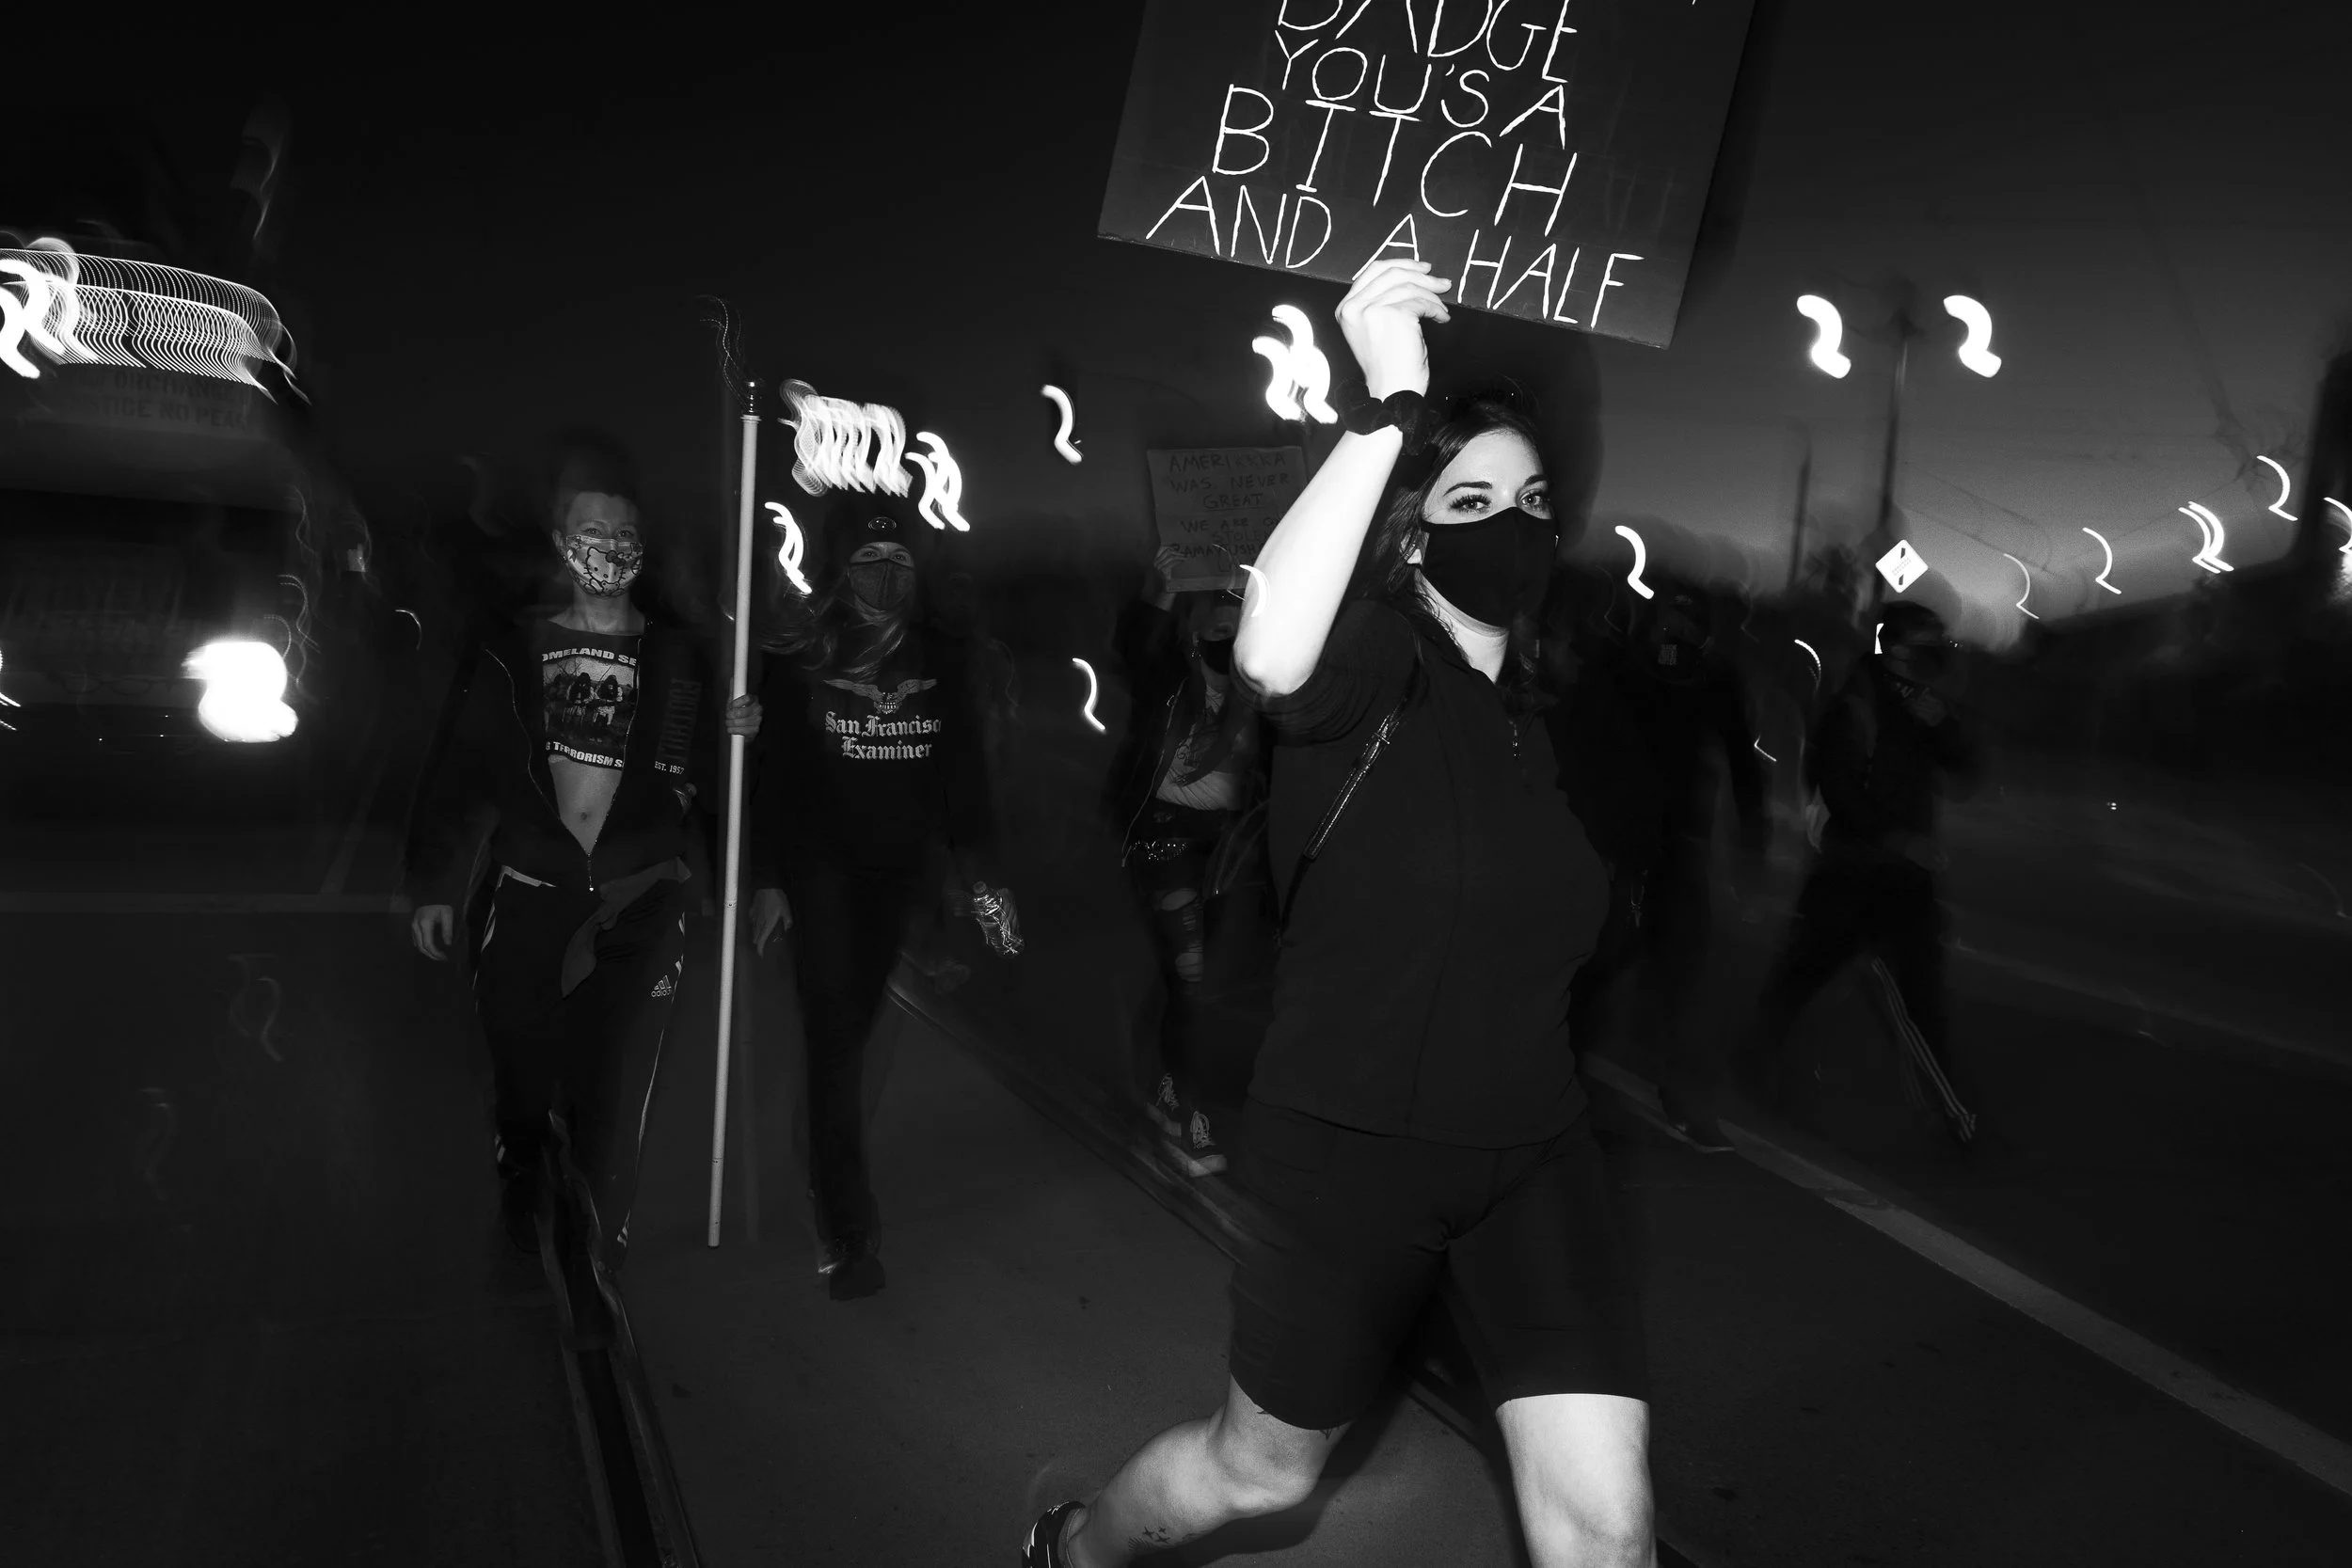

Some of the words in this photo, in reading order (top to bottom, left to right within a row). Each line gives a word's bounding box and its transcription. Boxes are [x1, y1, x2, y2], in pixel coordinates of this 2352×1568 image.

[1274, 29, 1489, 128] YOU'S
[1499, 84, 1565, 150] A
[1212, 83, 1578, 237] BITCH
[1145, 176, 1332, 269] AND
[1352, 213, 1420, 280] A
[1456, 229, 1645, 330] HALF
[1169, 477, 1213, 494] WAS
[1230, 473, 1290, 490] NEVER
[1202, 493, 1263, 510] GREAT
[1180, 519, 1209, 533] WE
[541, 647, 615, 662] OMELAND
[617, 654, 638, 667] SE
[825, 710, 861, 735] San
[862, 714, 942, 737] Francisc
[553, 741, 614, 767] TERRORISM
[841, 736, 933, 761] Examiner
